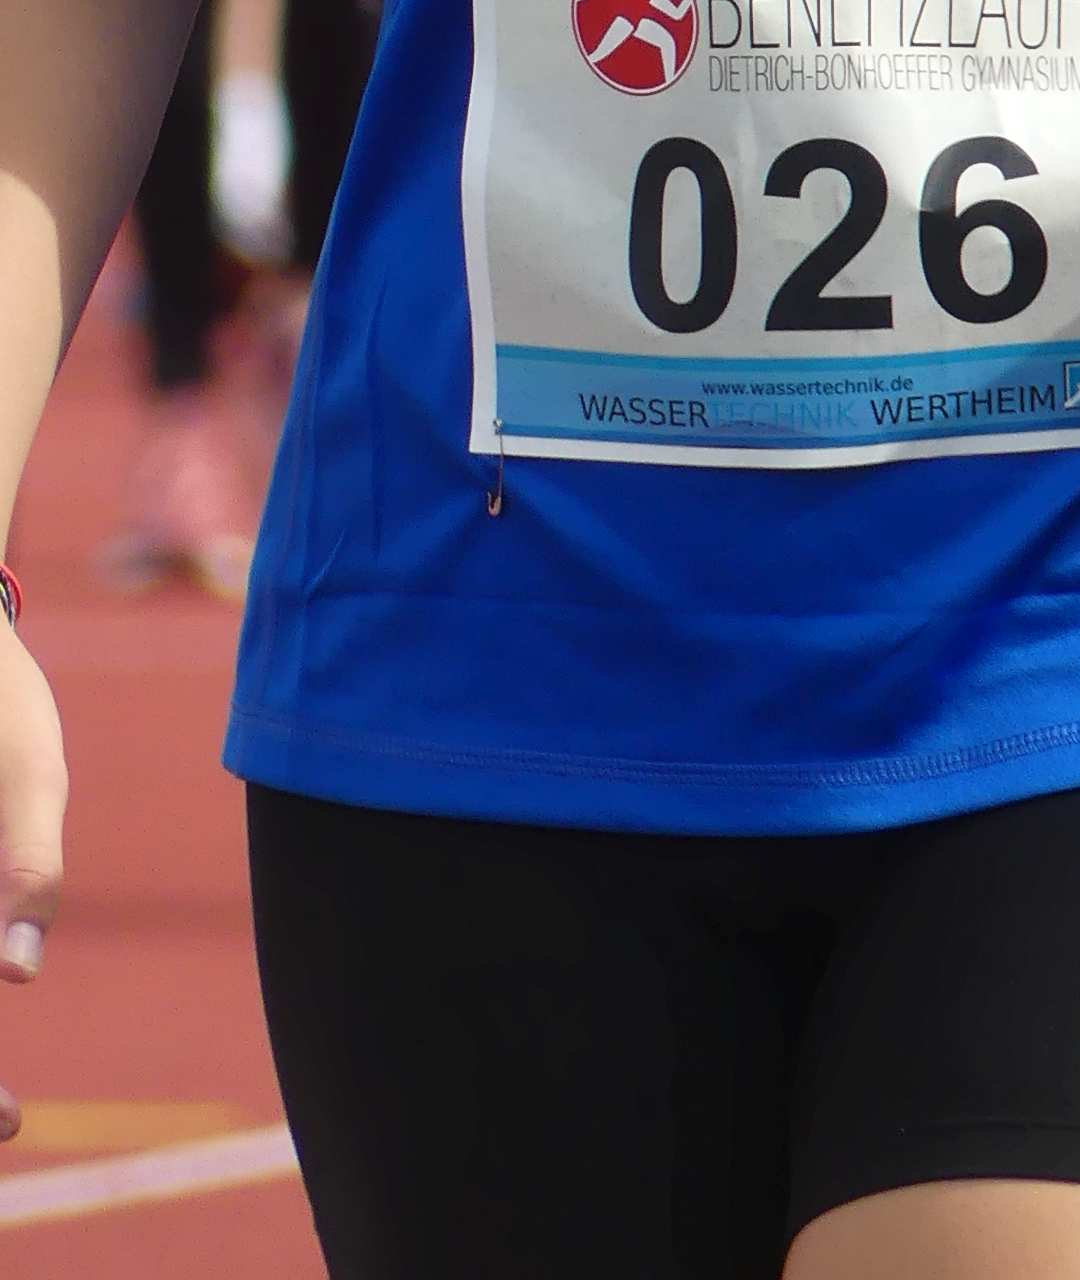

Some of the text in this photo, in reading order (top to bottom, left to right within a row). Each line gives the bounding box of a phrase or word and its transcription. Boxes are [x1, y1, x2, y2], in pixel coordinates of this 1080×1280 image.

[709, 53, 952, 93] DIETRICH-BONHOEFFER
[628, 135, 1049, 335] 026
[701, 374, 914, 397] www.wassertechnik.de
[870, 383, 1057, 426] WERTHEIM
